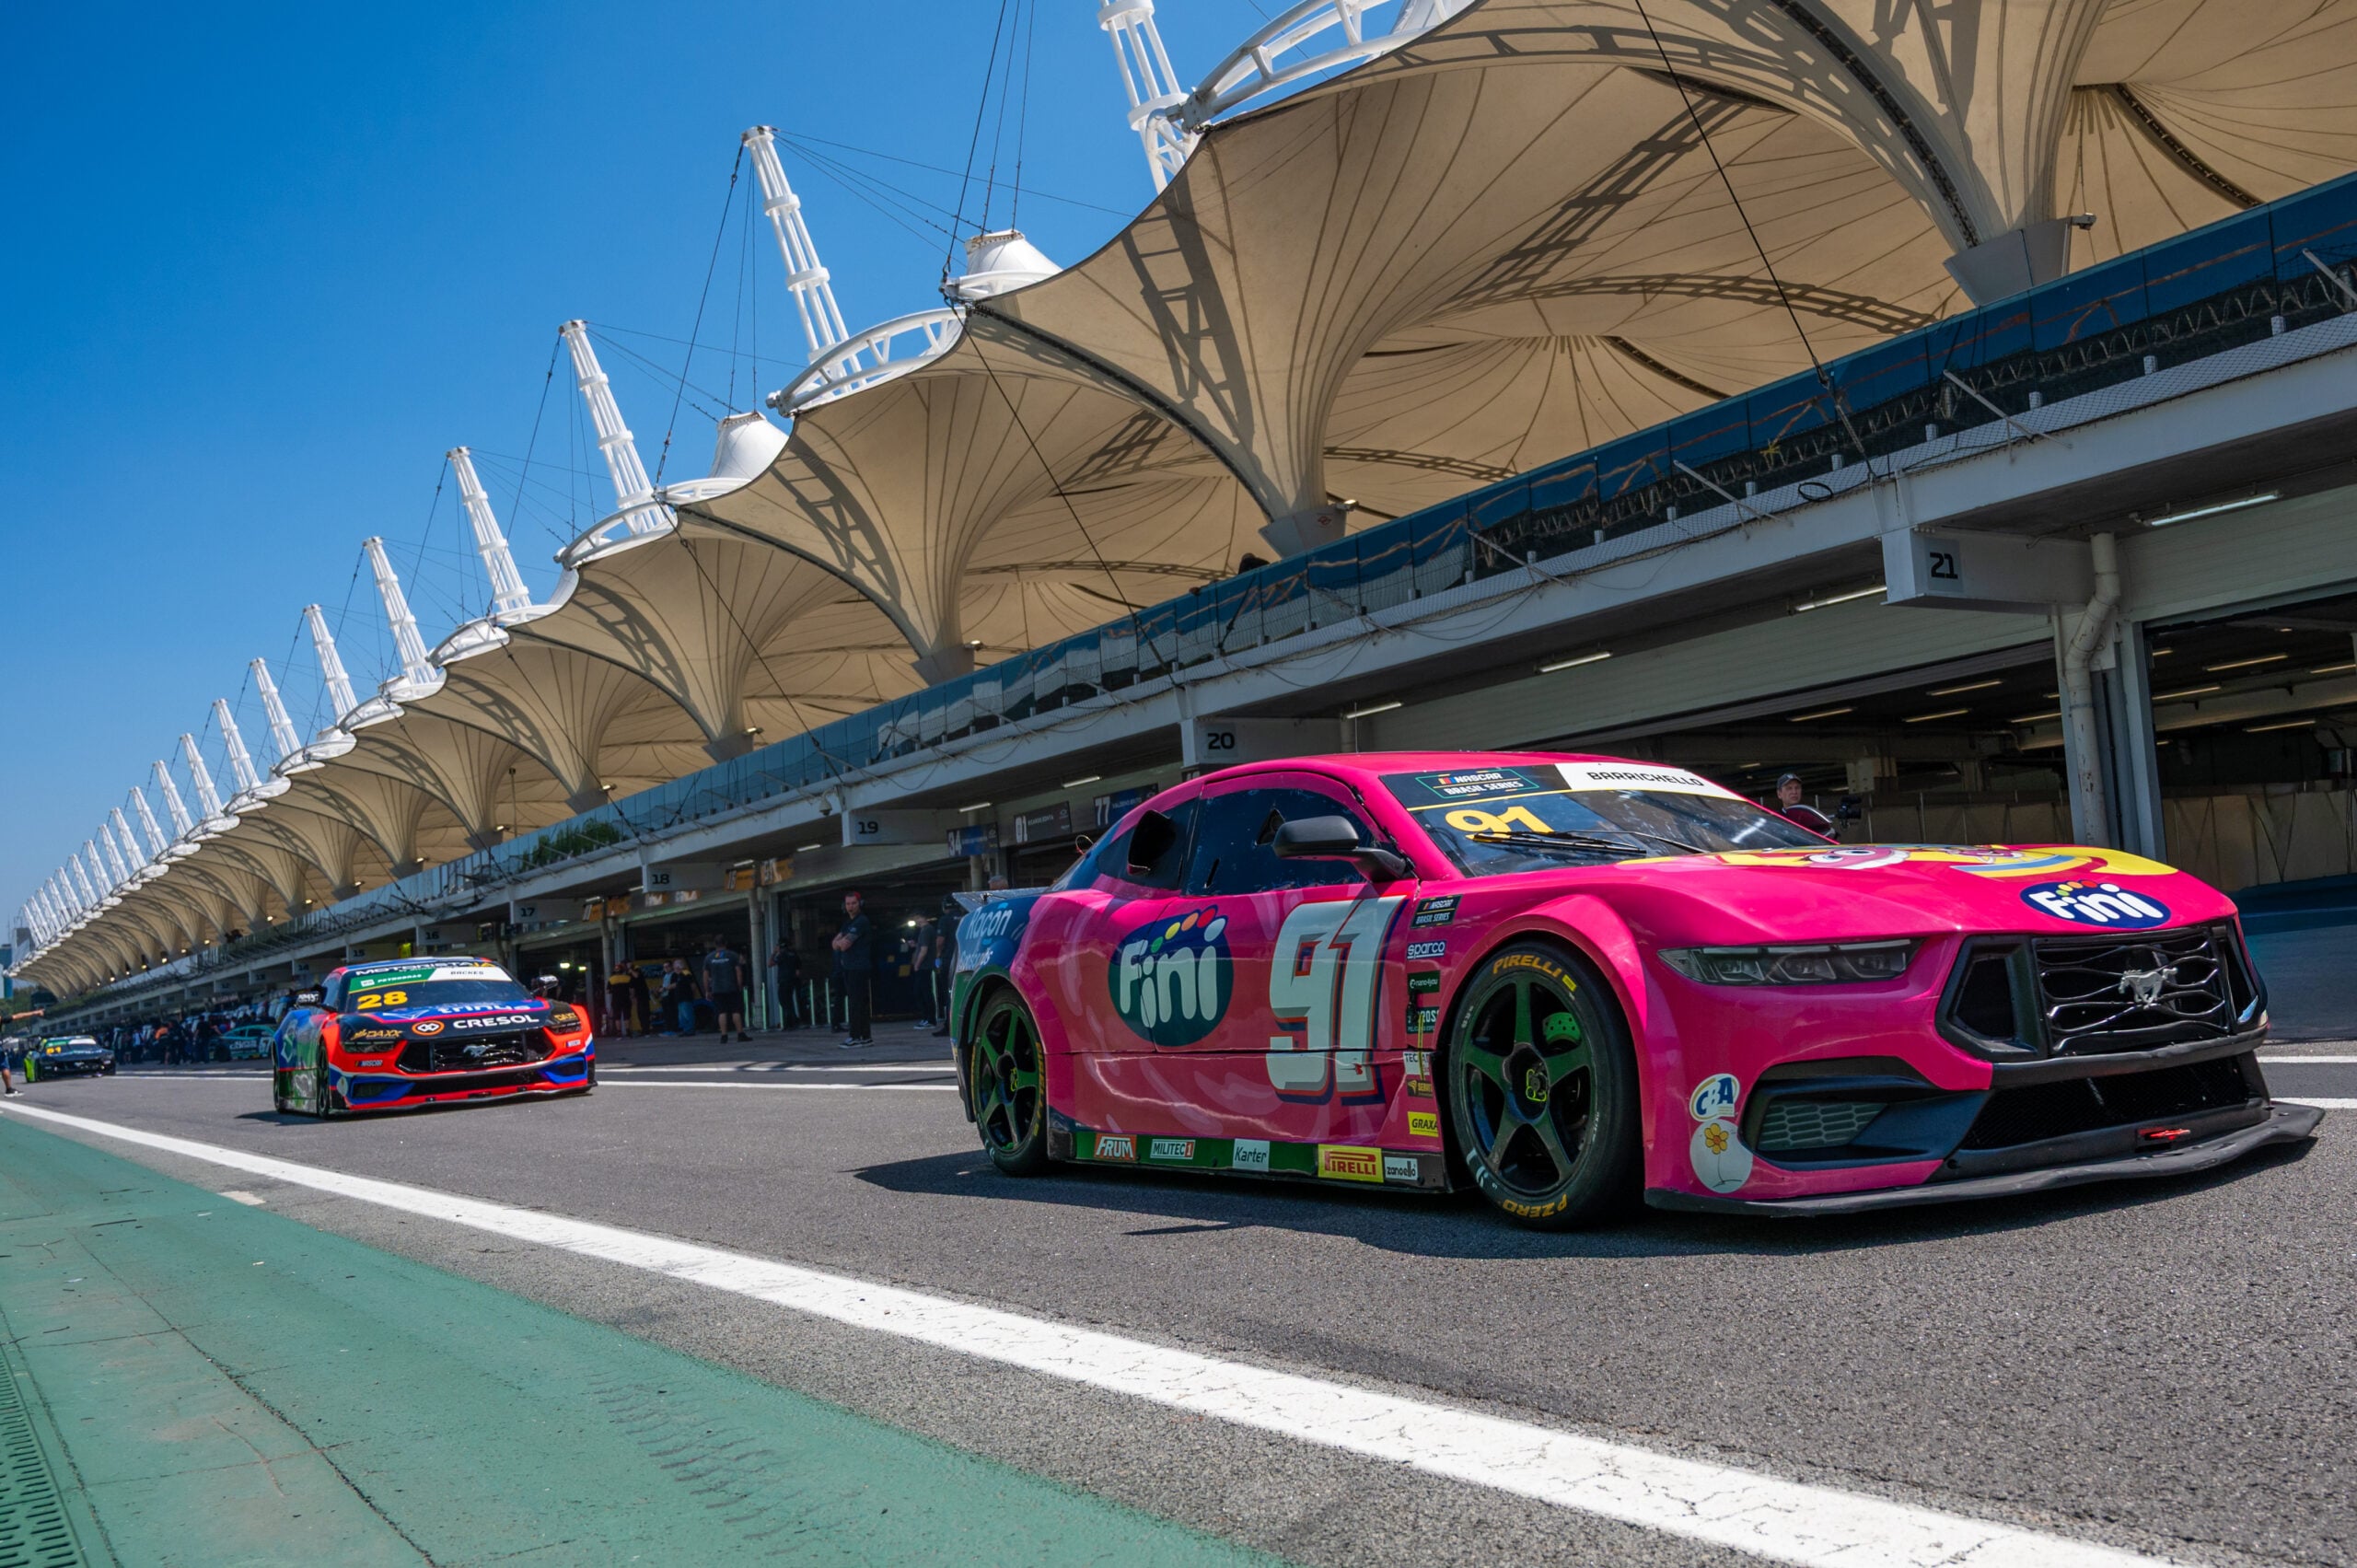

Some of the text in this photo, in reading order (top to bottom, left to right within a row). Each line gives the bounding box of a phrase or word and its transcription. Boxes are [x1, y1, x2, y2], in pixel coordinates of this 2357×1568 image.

[1930, 552, 1958, 579] 21
[1207, 732, 1235, 749] 20
[1454, 772, 1504, 784] NASCAR
[1586, 772, 1704, 786] BARRICHELLO
[1444, 781, 1525, 795] BRASIL SERIES
[1095, 796, 1110, 826] 77
[858, 821, 879, 834] 19
[1445, 806, 1555, 842] 91
[948, 830, 962, 855] 34
[652, 874, 669, 885] 18
[2028, 883, 2164, 922] Fini
[520, 907, 535, 917] 17
[425, 931, 439, 940] 16
[1408, 942, 1446, 958] sparco
[1120, 917, 1225, 1028] Fini
[1492, 954, 1562, 978] PIRELLI
[357, 991, 408, 1009] 28
[1266, 894, 1409, 1100] 91
[452, 1015, 540, 1028] CRESOL
[366, 1029, 404, 1038] DAXX
[1697, 1077, 1734, 1115] CBA
[1097, 1136, 1134, 1158] FRUM
[1235, 1146, 1267, 1163] Karter
[1324, 1151, 1376, 1175] PIRELLI
[1503, 1199, 1555, 1218] ZERO
